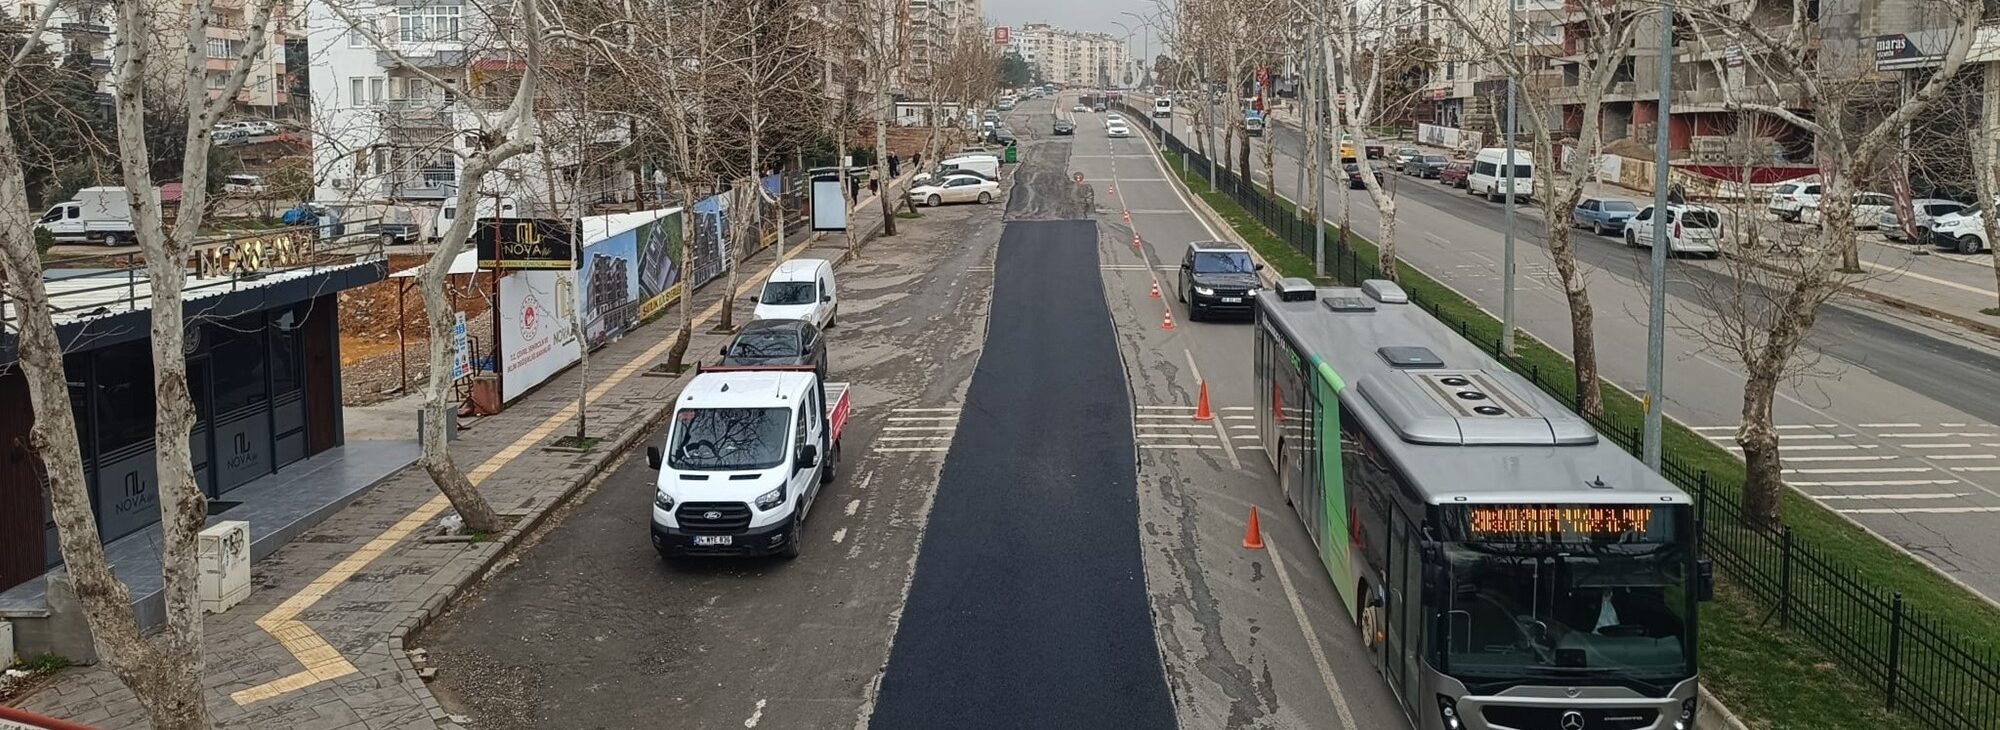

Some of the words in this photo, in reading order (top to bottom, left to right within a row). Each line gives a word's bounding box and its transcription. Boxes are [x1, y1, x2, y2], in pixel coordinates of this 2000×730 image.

[504, 244, 541, 255] NOVA
[227, 454, 252, 469] NOVA
[115, 493, 147, 514] NOVA
